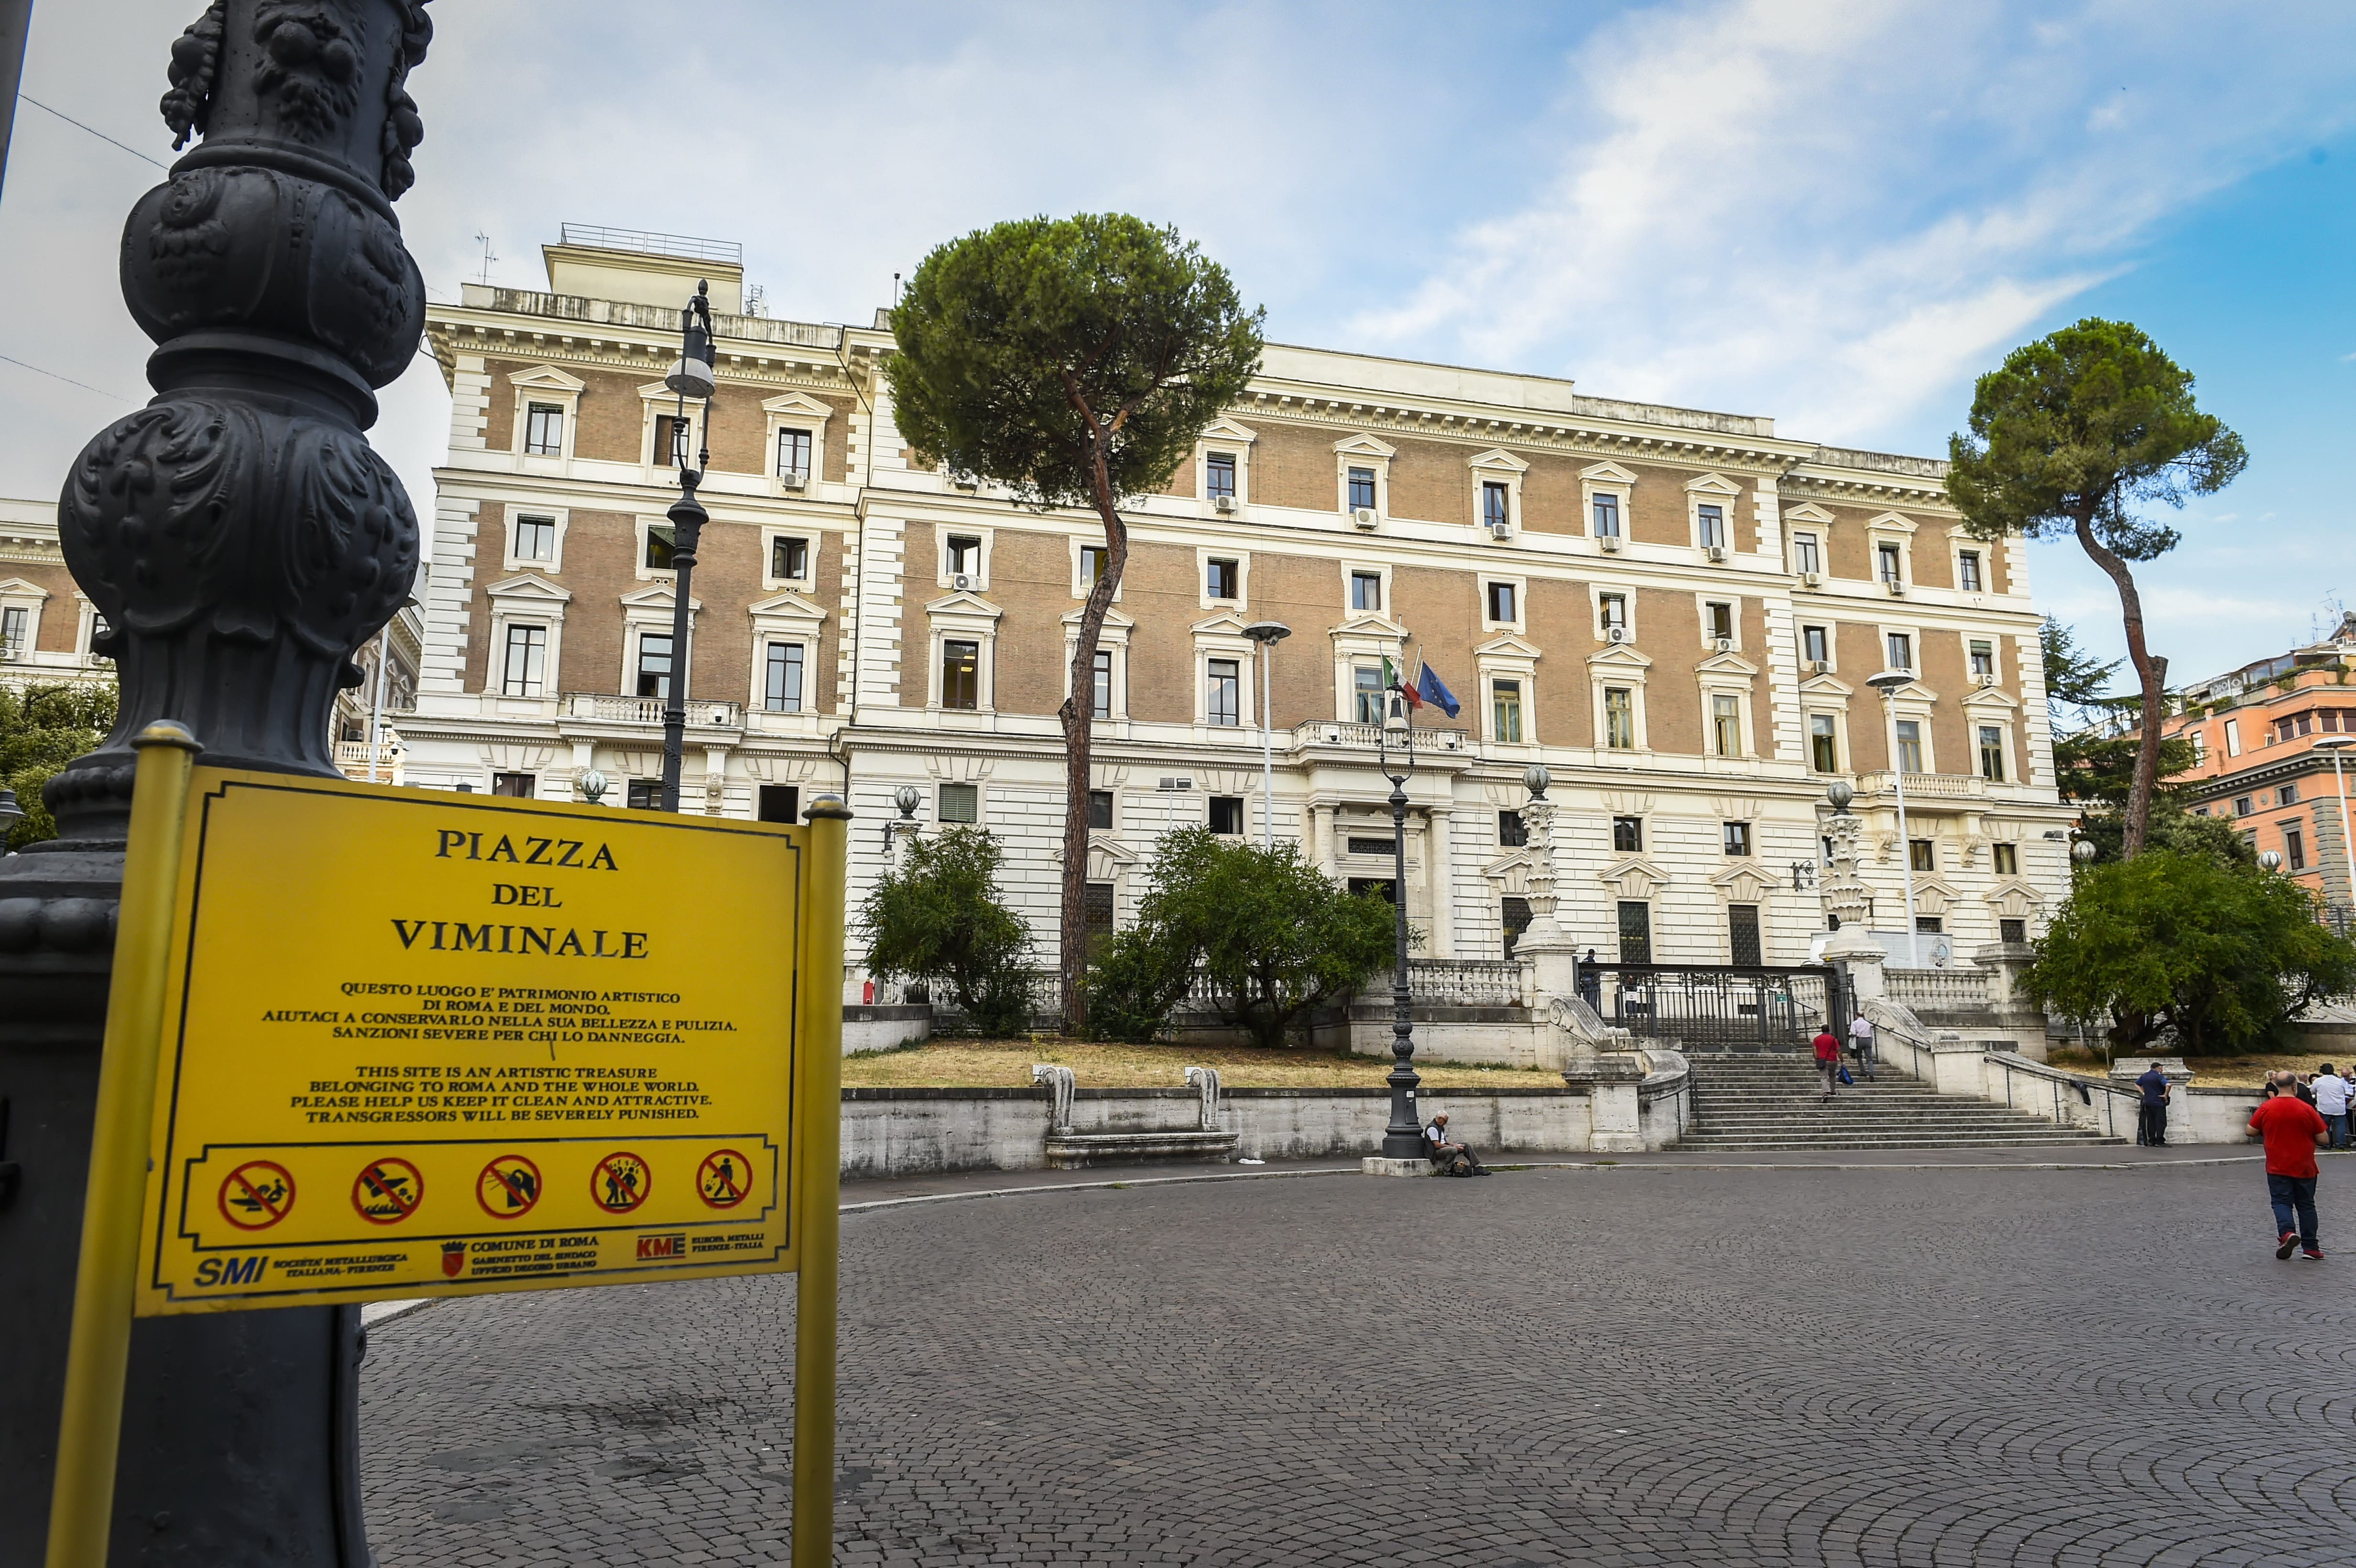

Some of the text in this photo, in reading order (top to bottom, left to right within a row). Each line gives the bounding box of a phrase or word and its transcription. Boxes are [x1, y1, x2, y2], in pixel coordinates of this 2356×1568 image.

[435, 829, 618, 871] PIAZZA
[491, 884, 562, 907] DEL
[391, 919, 648, 958] VIMINALE
[341, 982, 680, 1003] QUESTO LUOGO E' PATRIMONIO ARTISTICO
[422, 1000, 611, 1015] DI ROMA E DEL MONDO.
[262, 1011, 737, 1032] AIUTACI A CONSERVARLO NELLA SUA BELLEZZA E PULIZIA.
[332, 1027, 685, 1044] SANZIONI SEVERE PER CHI LO DANNEGGIA.
[356, 1067, 657, 1078] THIS SITE IS AN ARTISTIC TREASURE
[309, 1081, 699, 1092] BELONGING TO ROMA AND THE WHOLE WORLD.
[290, 1095, 712, 1108] PLEASE HELP US KEEP IT CLEAN AND ATTRACTIVE.
[306, 1109, 699, 1123] TRANSGRESSORS WILL BE SEVERELY PUNISHED.
[471, 1236, 600, 1252] COMUNE DI ROMA
[692, 1233, 764, 1244] EUROPA METALLI
[636, 1237, 686, 1257] KME
[555, 1251, 597, 1260] SINDACO
[194, 1256, 269, 1287] SMI
